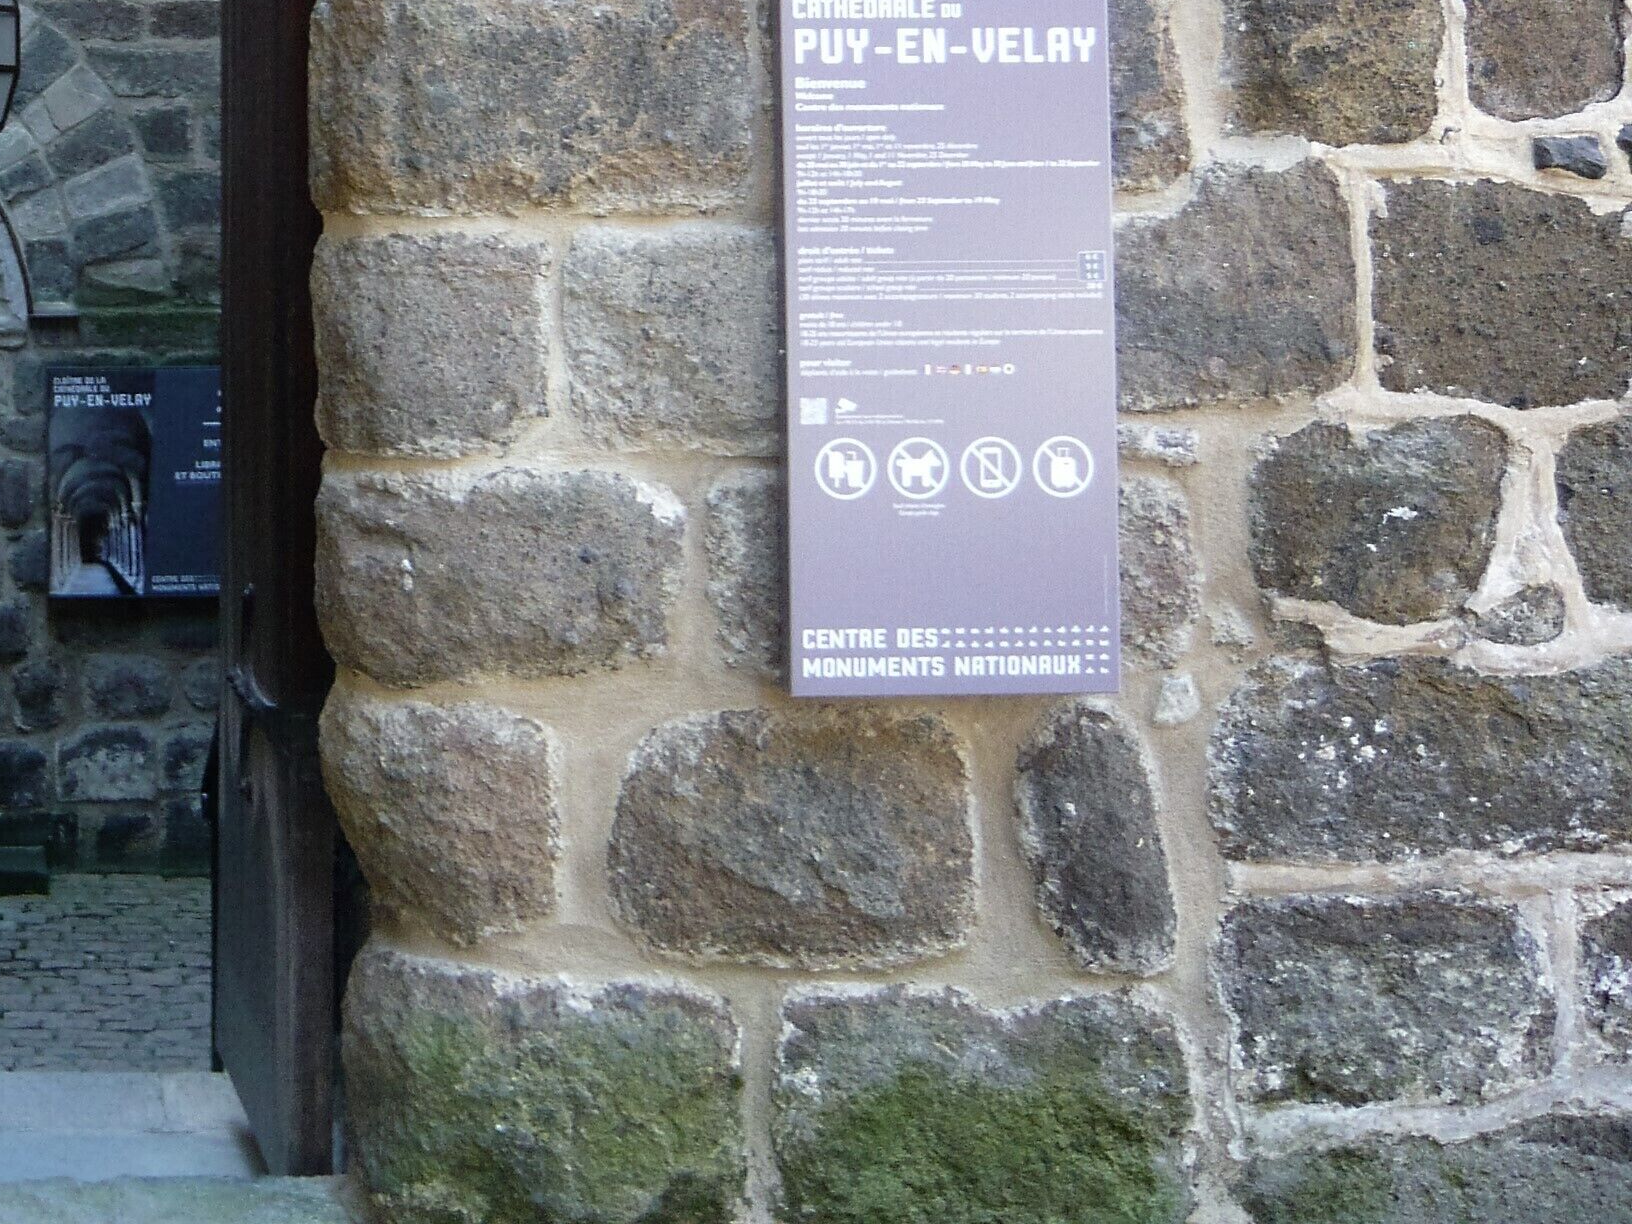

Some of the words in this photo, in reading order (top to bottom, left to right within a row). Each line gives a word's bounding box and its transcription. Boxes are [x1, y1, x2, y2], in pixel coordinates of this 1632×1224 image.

[940, 3, 961, 18] DU
[794, 27, 1096, 64] PUY-EN-VELAY
[54, 393, 151, 407] PUY-EN-VELAY
[803, 628, 887, 649] CENTRE
[896, 627, 938, 649] DES
[803, 656, 945, 677] MONUMENTS
[954, 654, 1081, 676] NATIONAUX
